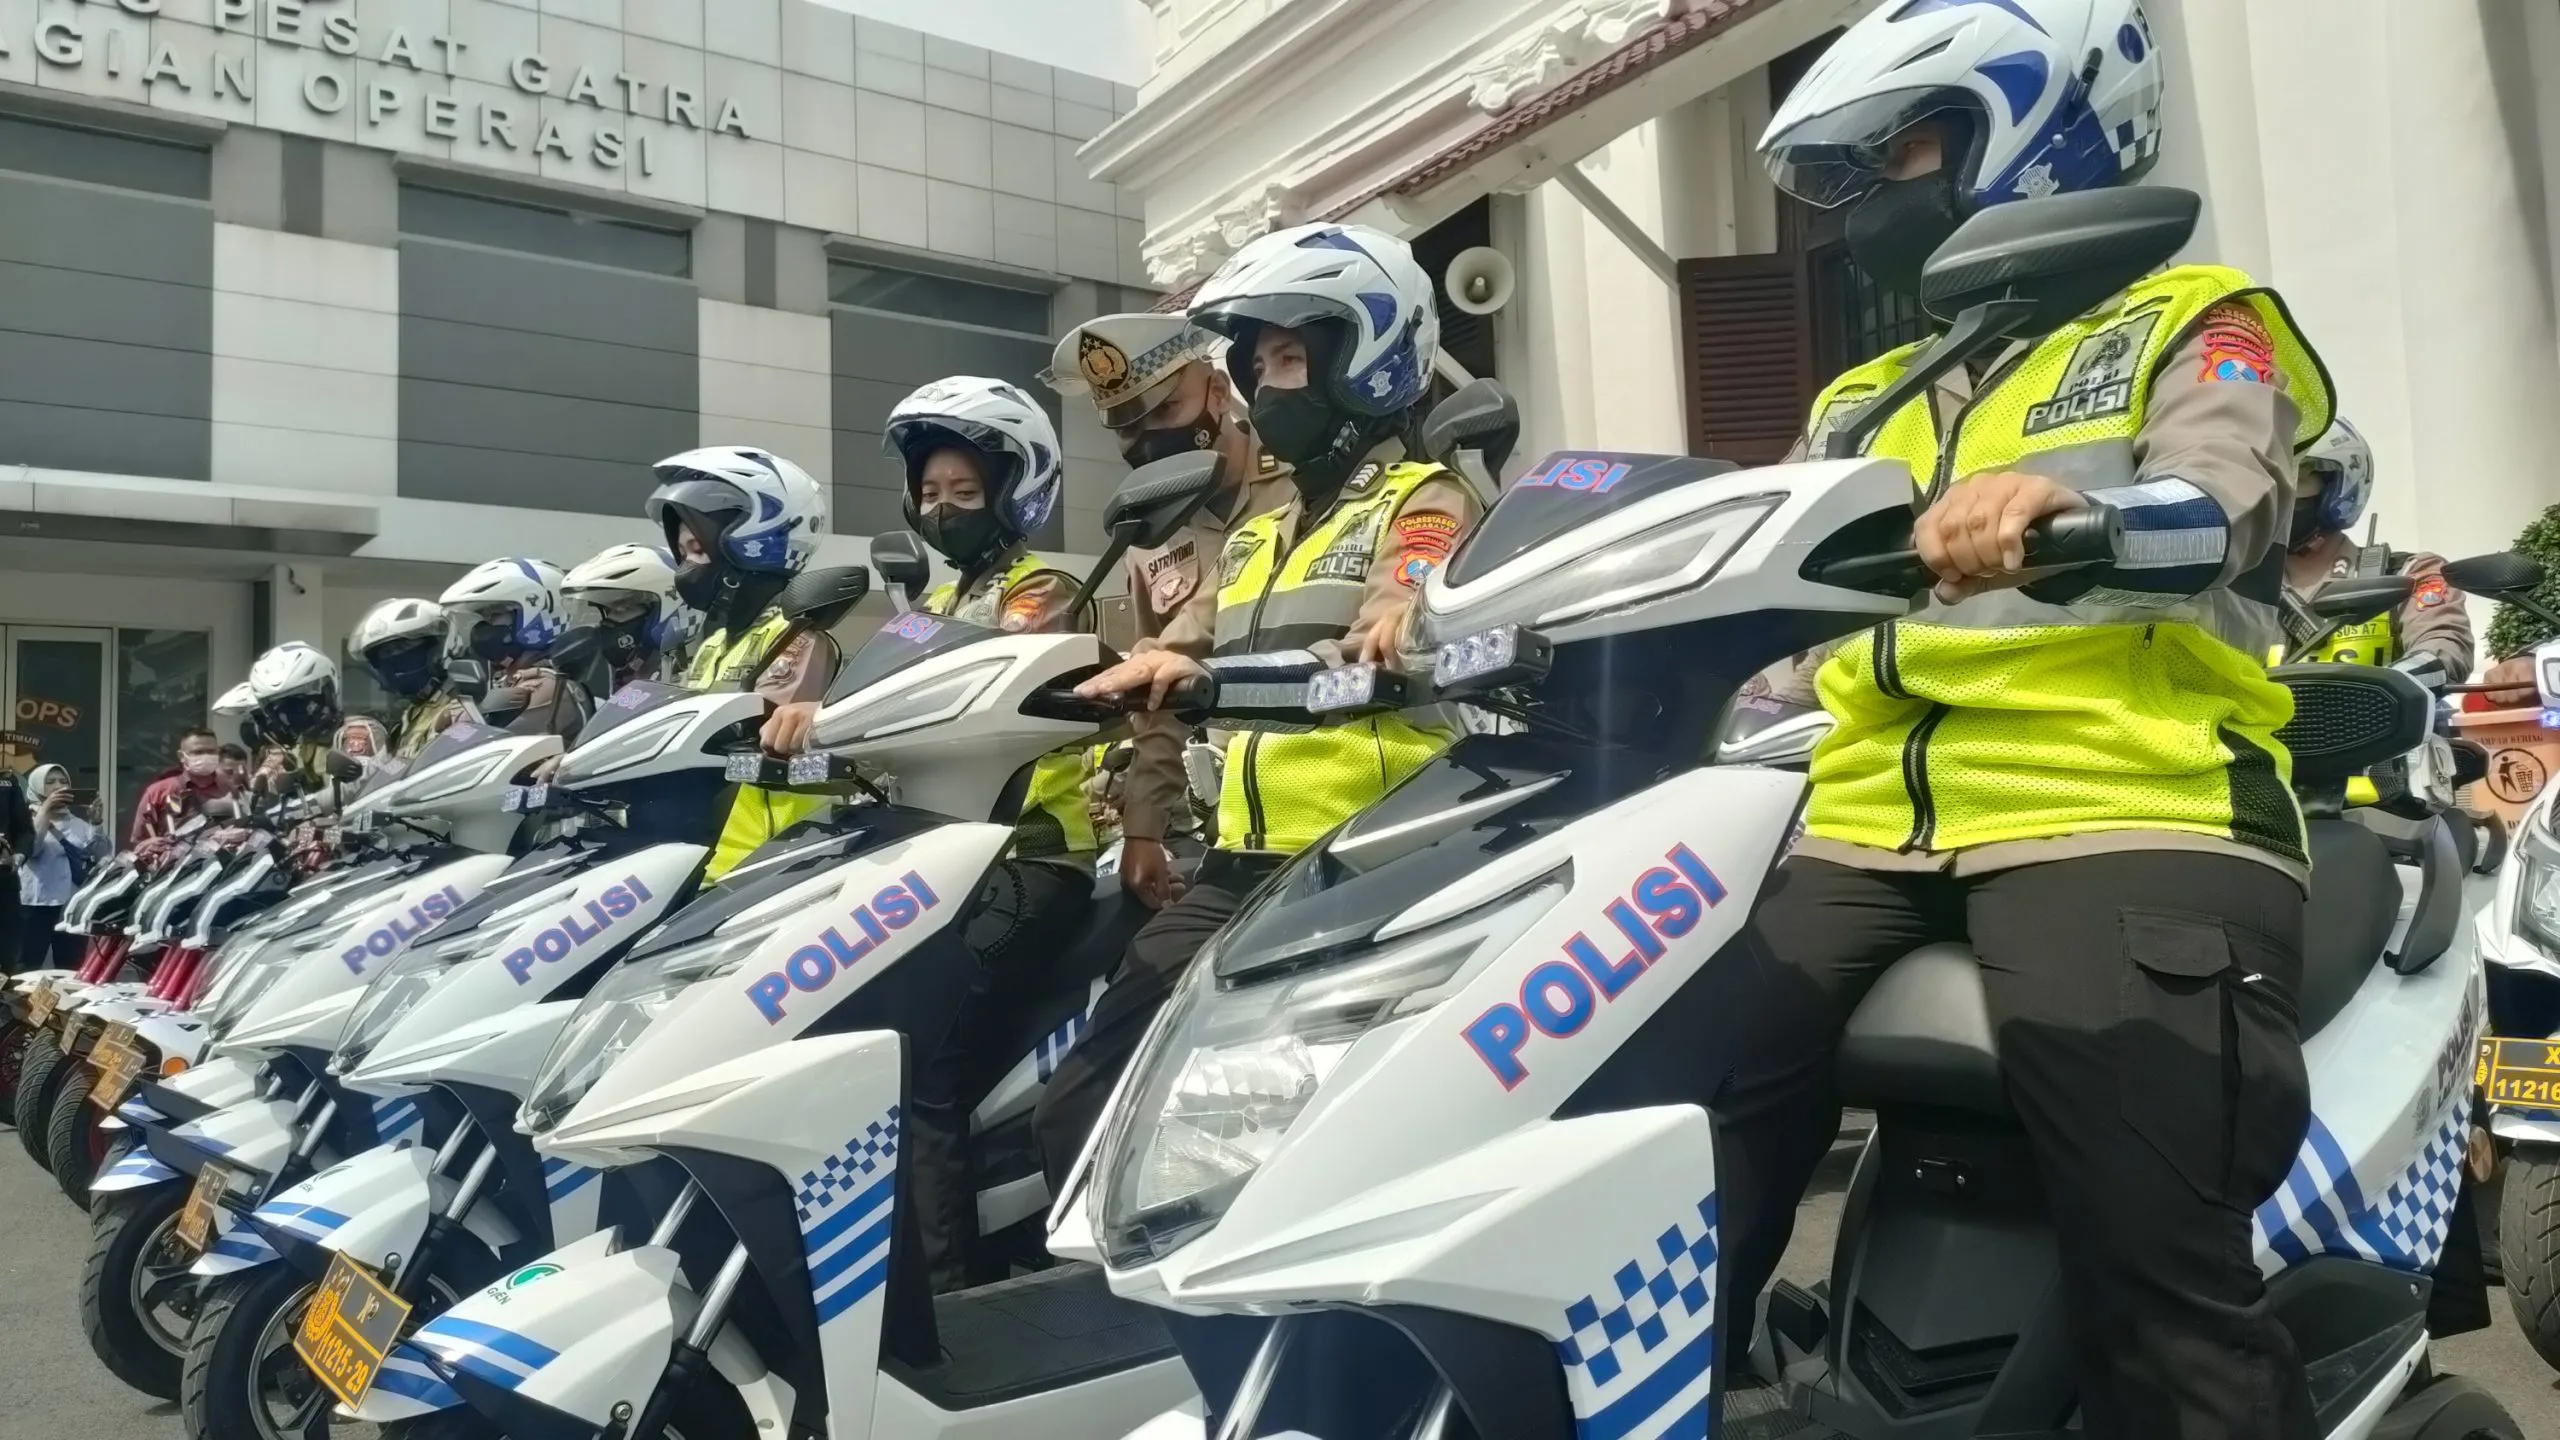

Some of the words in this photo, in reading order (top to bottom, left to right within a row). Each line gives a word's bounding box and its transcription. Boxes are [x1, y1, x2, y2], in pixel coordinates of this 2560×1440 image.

[0, 17, 255, 102] GIAN
[303, 71, 653, 175] OPERASI
[213, 0, 467, 77] PESAT
[510, 54, 751, 138] GATRA
[2025, 382, 2130, 430] POLISI
[1306, 556, 1370, 578] POLISI
[16, 700, 79, 727] OPS
[340, 884, 465, 976] POLISI
[501, 874, 653, 986] POLISI
[744, 870, 940, 1026] POLISI
[1460, 841, 1728, 1093] POLISI
[2496, 1078, 2560, 1102] 11216
